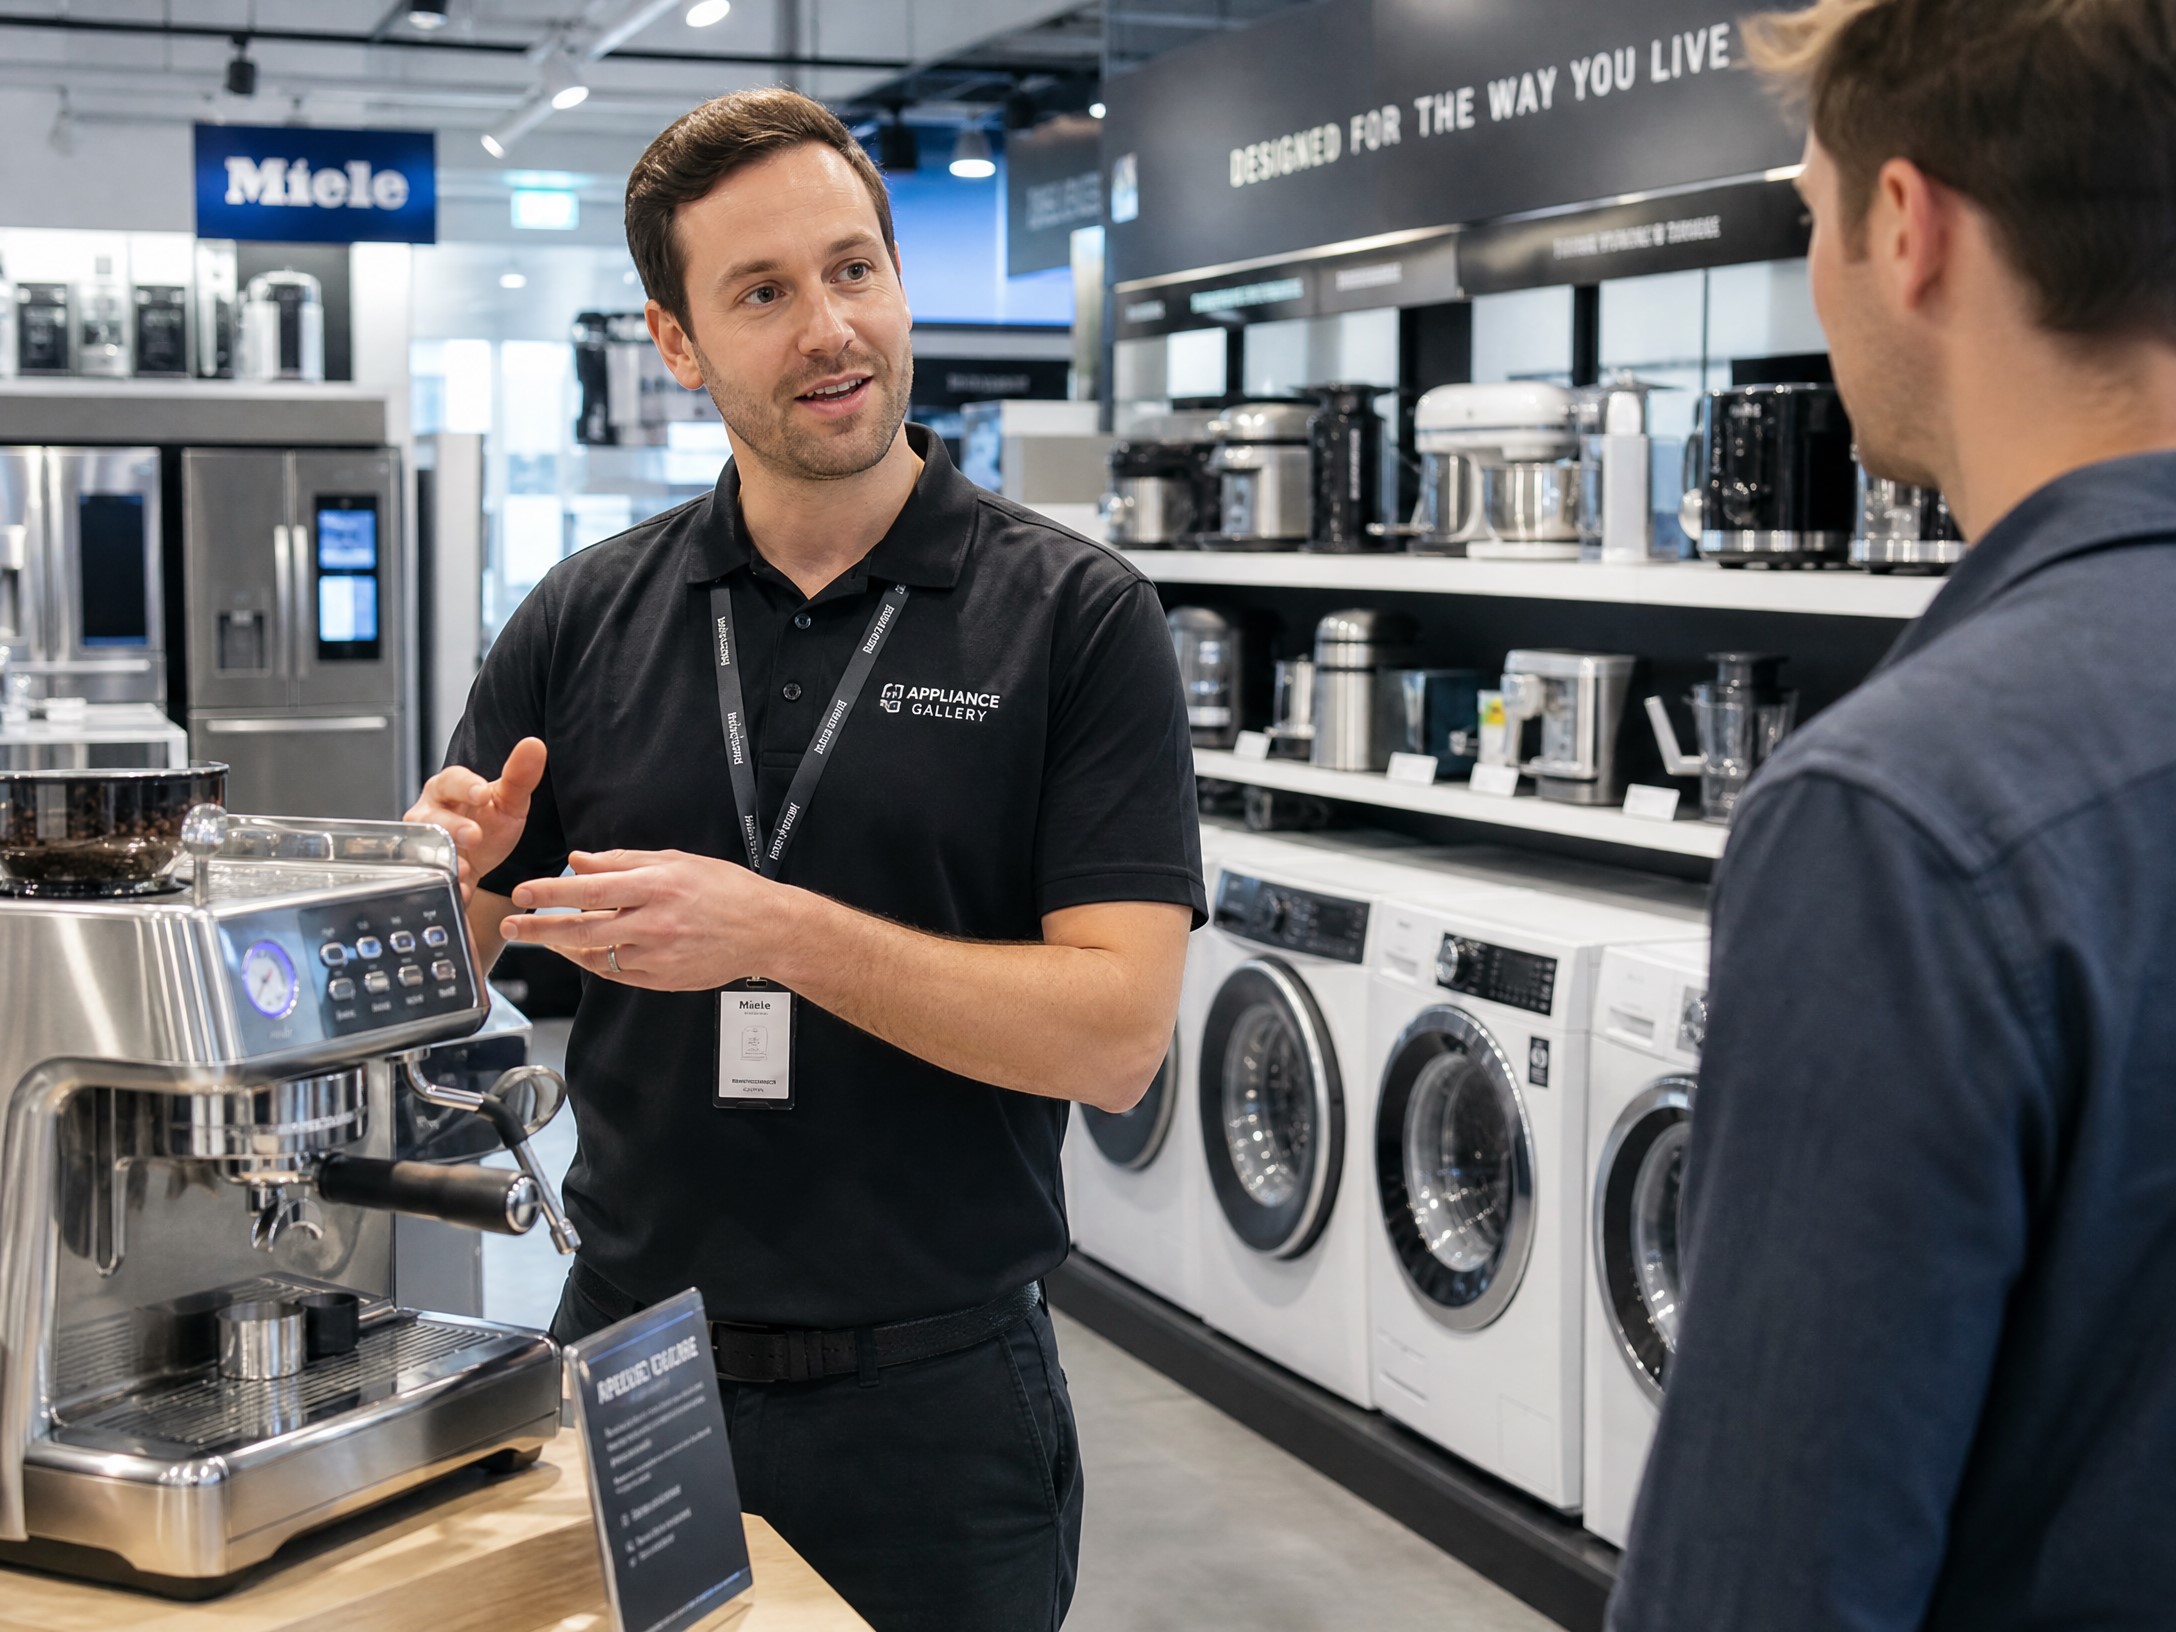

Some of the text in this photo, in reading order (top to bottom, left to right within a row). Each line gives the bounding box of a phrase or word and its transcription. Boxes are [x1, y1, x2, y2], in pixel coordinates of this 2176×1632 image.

[1230, 22, 1731, 188] DESIGNED FOR THE WAY YOU LIVE
[224, 155, 410, 211] Miele
[906, 686, 1000, 708] APPLIANCE
[912, 703, 987, 722] GALLERY
